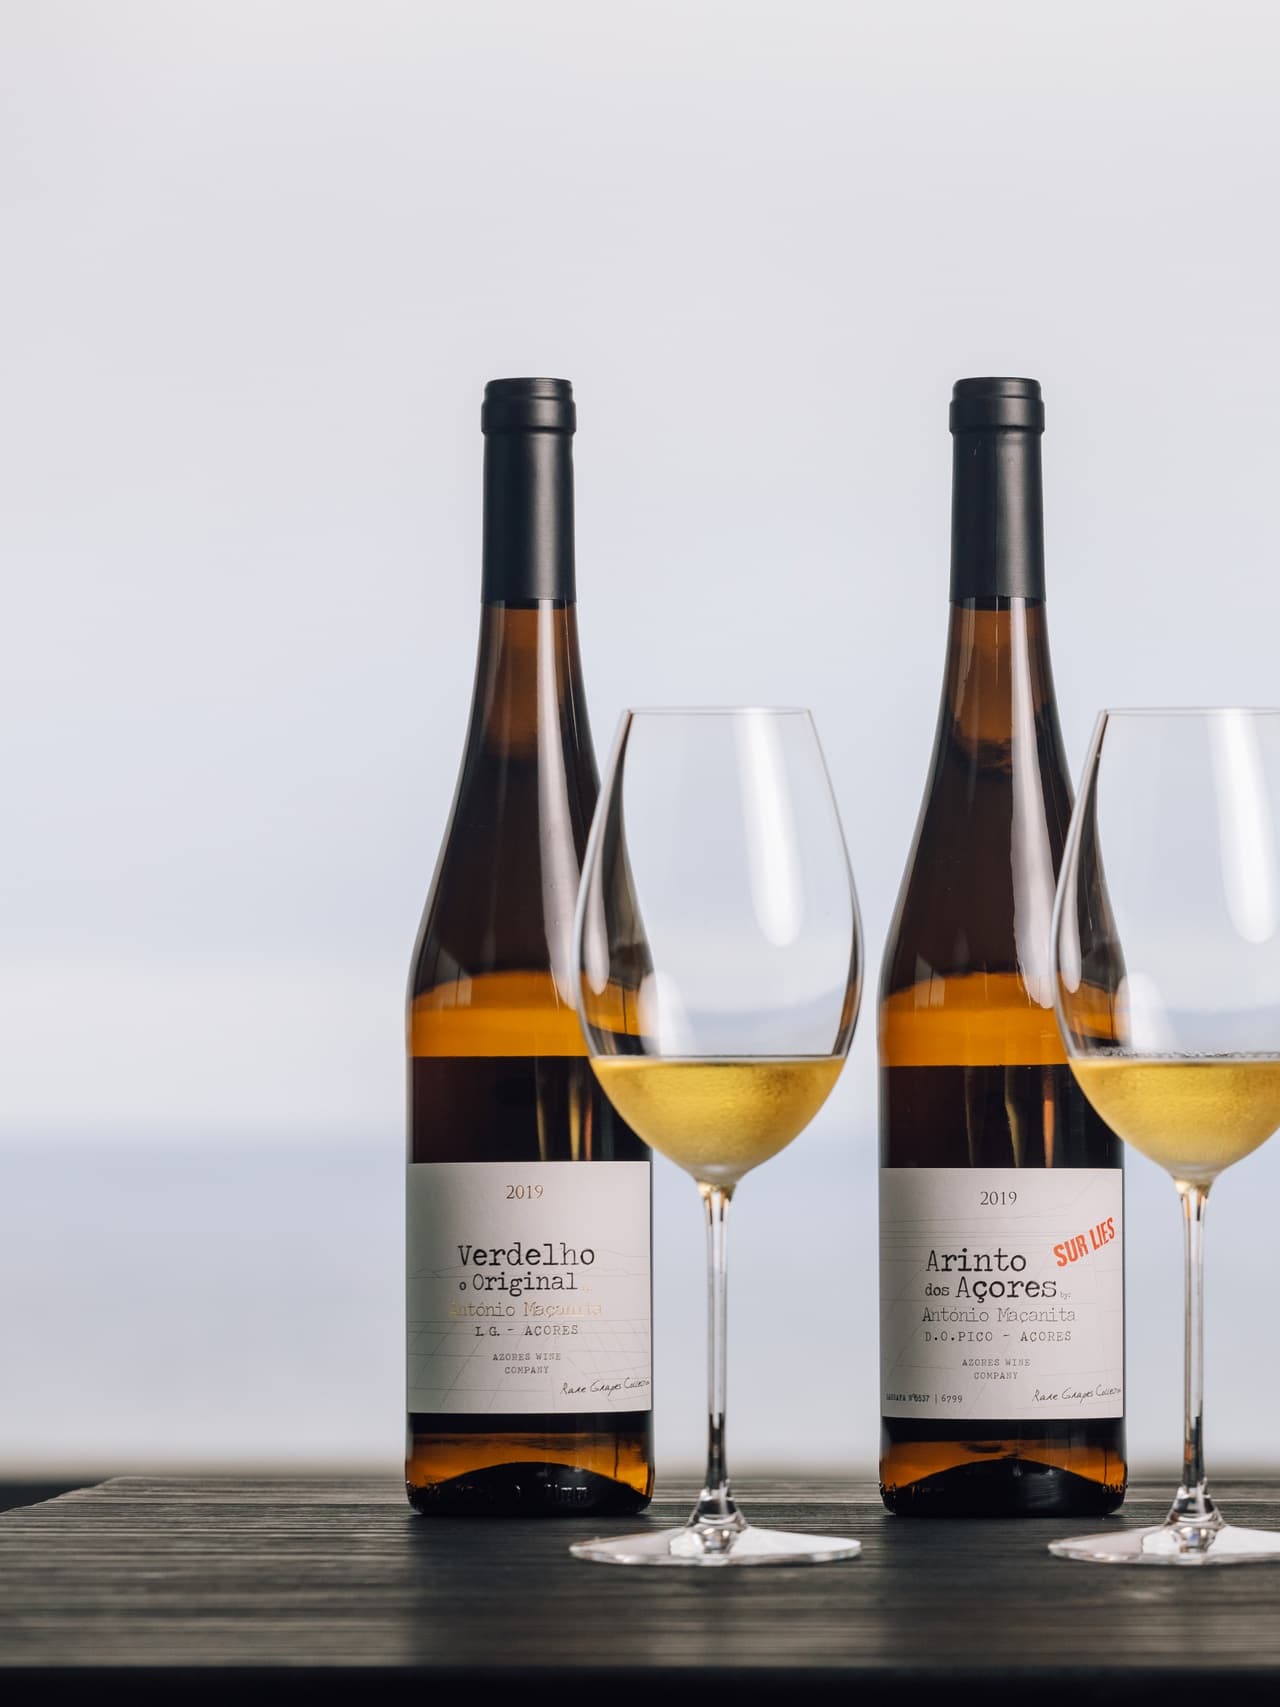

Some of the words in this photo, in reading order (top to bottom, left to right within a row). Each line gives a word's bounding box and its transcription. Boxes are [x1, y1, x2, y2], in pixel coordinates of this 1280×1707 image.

[506, 1184, 544, 1200] 2019
[980, 1191, 1017, 1206] 2019
[1052, 1234, 1089, 1267] SUR
[1089, 1217, 1116, 1250] LIES
[457, 1242, 595, 1266] Verdelho
[925, 1247, 1027, 1272] Arinto
[458, 1281, 467, 1291] o
[472, 1271, 578, 1297] Original
[924, 1283, 950, 1296] dos
[955, 1276, 1057, 1303] Açores
[450, 1300, 516, 1318] António
[922, 1307, 990, 1323] António
[997, 1307, 1076, 1326] Maçanita
[1020, 1331, 1072, 1344] AÇORES
[492, 1353, 531, 1362] AZORES
[535, 1352, 561, 1361] WINE
[961, 1358, 1000, 1367] AZORES
[1005, 1358, 1031, 1367] WINE
[504, 1366, 550, 1375] COMPANY
[974, 1371, 1018, 1380] COMPANY
[941, 1394, 963, 1403] 6799
